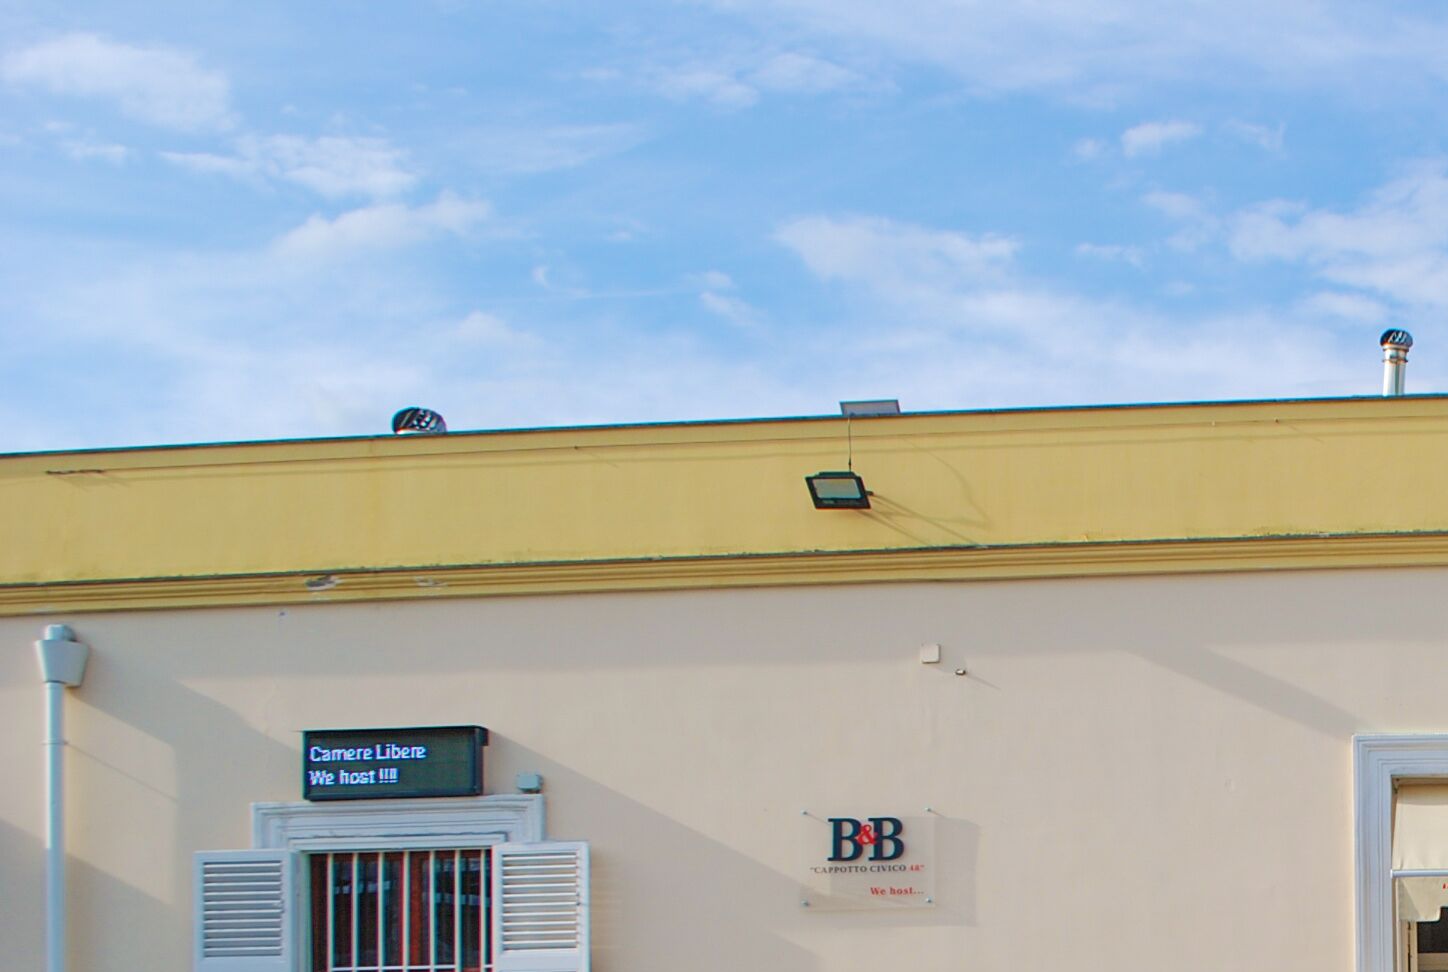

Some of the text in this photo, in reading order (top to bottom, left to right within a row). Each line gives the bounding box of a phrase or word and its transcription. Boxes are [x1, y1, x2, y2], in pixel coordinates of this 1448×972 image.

[310, 744, 427, 761] Camere Libere
[308, 769, 335, 785] We
[339, 769, 376, 784] host
[827, 817, 904, 861] B&B
[869, 864, 907, 873] CIVICO
[870, 887, 886, 896] We
